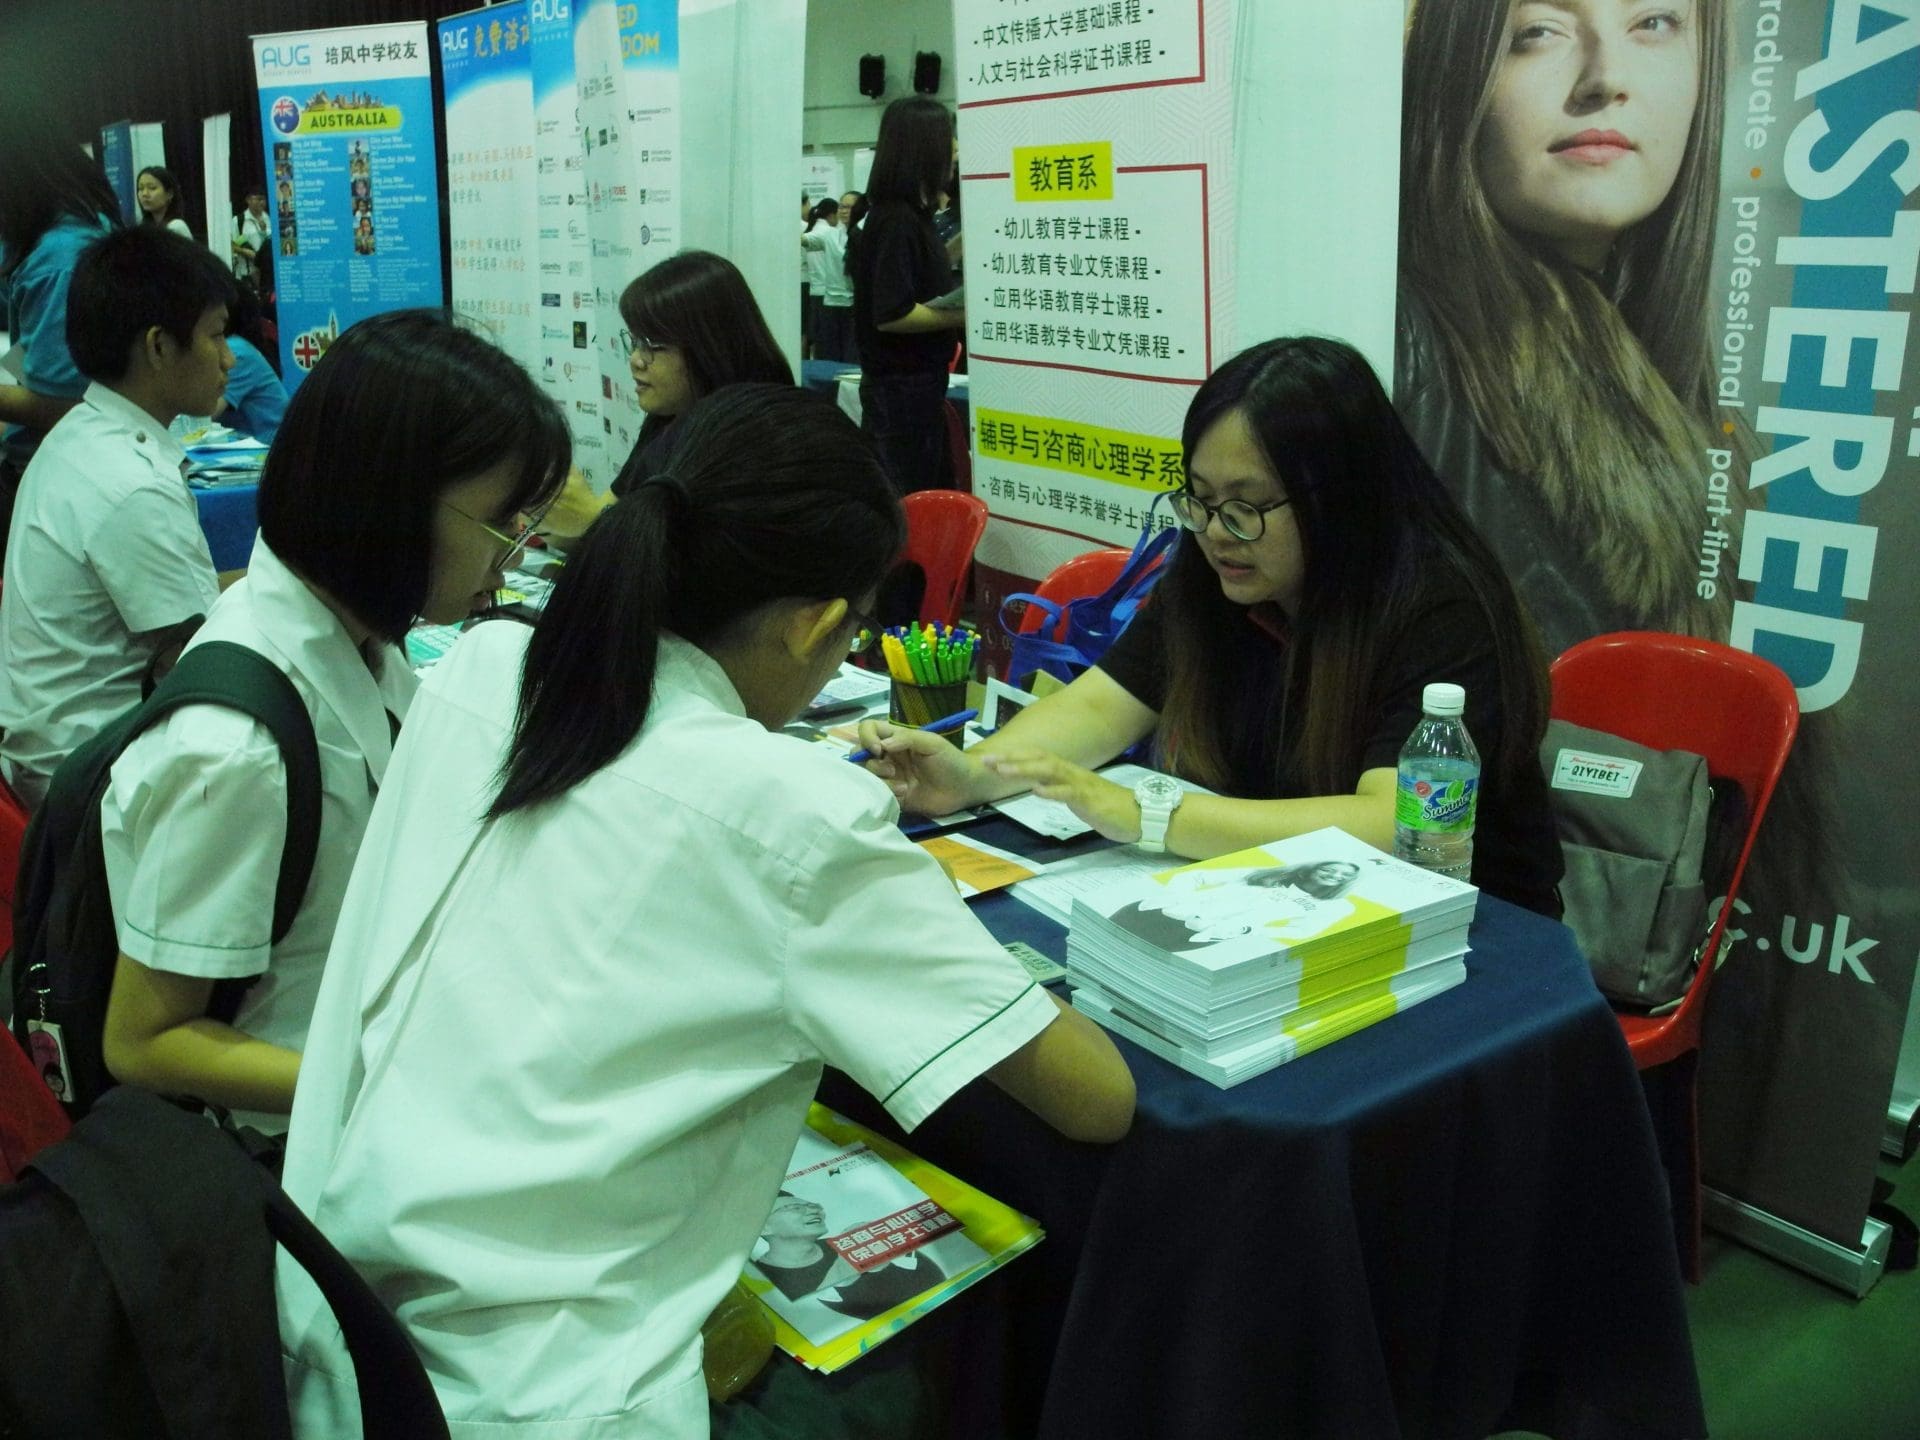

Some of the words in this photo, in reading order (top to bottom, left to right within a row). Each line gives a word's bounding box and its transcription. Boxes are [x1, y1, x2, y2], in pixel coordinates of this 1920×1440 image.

[532, 0, 569, 24] AUG
[983, 0, 1142, 49] 中文传播大学基础课程
[325, 39, 419, 65] 培风中学校友
[441, 27, 469, 52] AUG
[261, 44, 311, 69] AUG
[977, 38, 1153, 86] 人文与社会科学证书课程
[310, 111, 388, 129] AUSTRALIA
[1029, 153, 1098, 192] 教育系
[1003, 216, 1130, 241] 幼儿教育学士课程
[991, 252, 1149, 281] 幼儿教育专业文凭课程
[993, 286, 1150, 319] 应用华语教育学士课程
[1718, 196, 1761, 408] professional
[981, 319, 1172, 359] 应用华语教学专业文凭课程
[980, 417, 1185, 487] 辅导与咨商心理学系
[1696, 447, 1733, 600] part-time
[1571, 765, 1621, 782] QIYIBEI
